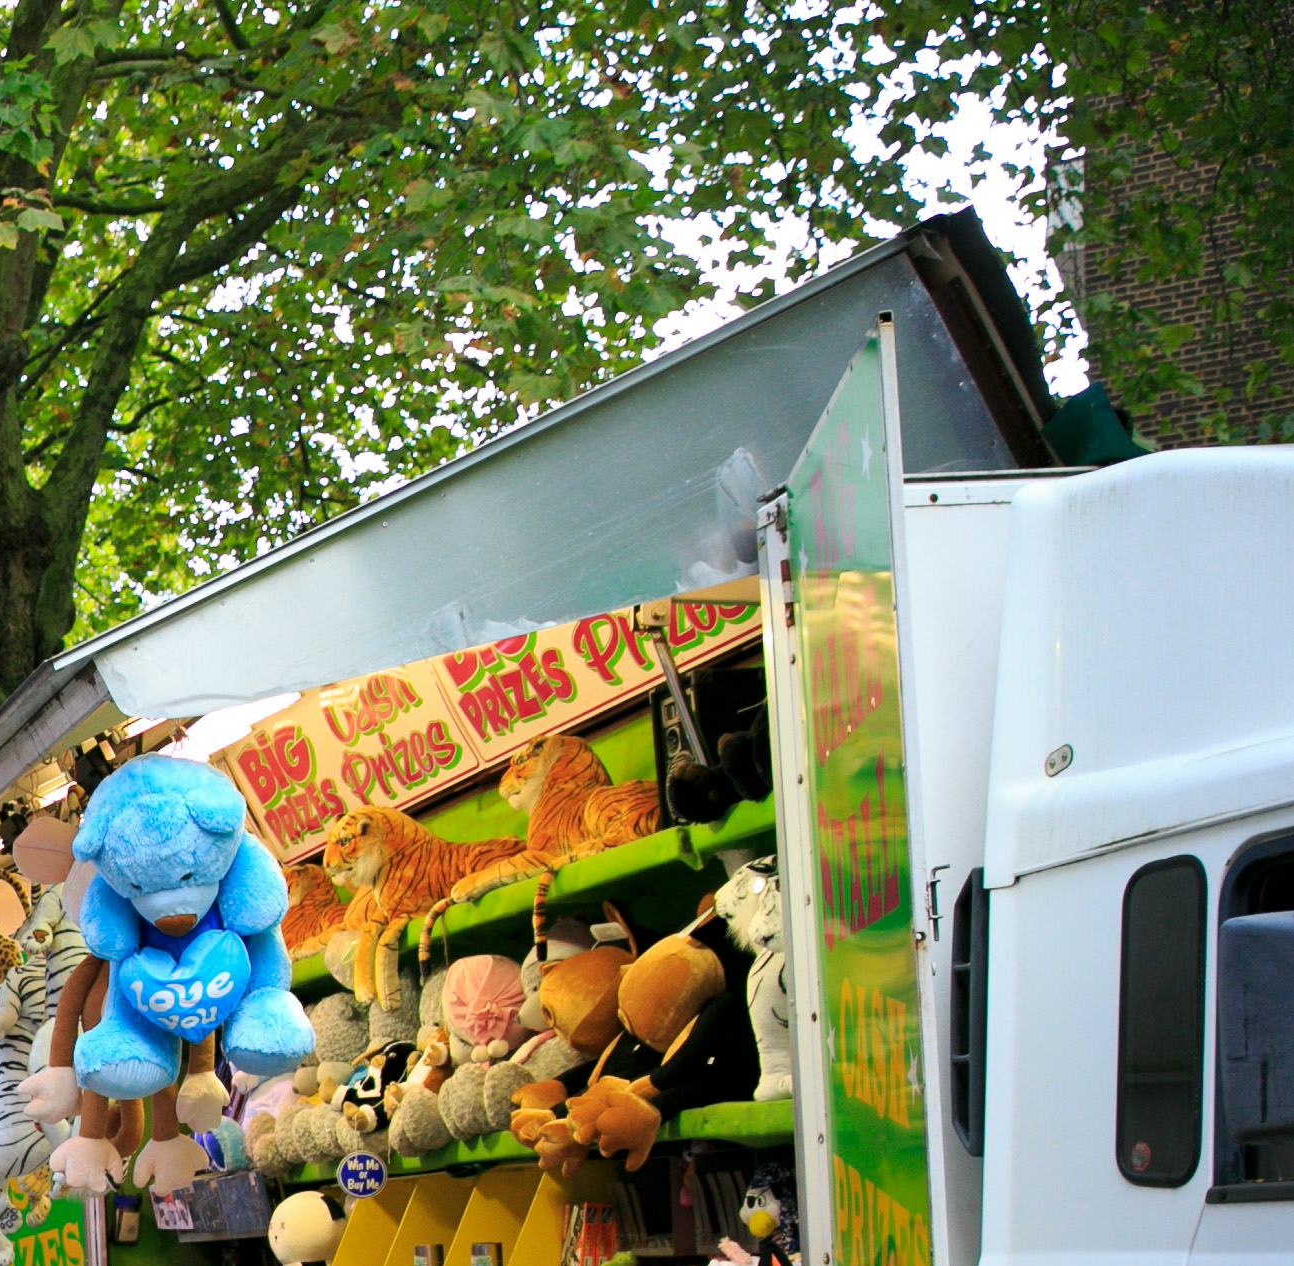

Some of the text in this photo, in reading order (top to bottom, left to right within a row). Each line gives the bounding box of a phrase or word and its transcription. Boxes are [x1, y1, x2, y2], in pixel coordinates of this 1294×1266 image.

[459, 647, 577, 743] PRIZES
[341, 718, 462, 809] Prizes
[263, 777, 349, 850] PRIZES
[157, 1006, 218, 1030] you
[839, 976, 911, 1129] CASH
[347, 1158, 380, 1171] Win Me
[347, 1178, 380, 1193] Buy Me
[359, 1171, 368, 1179] or
